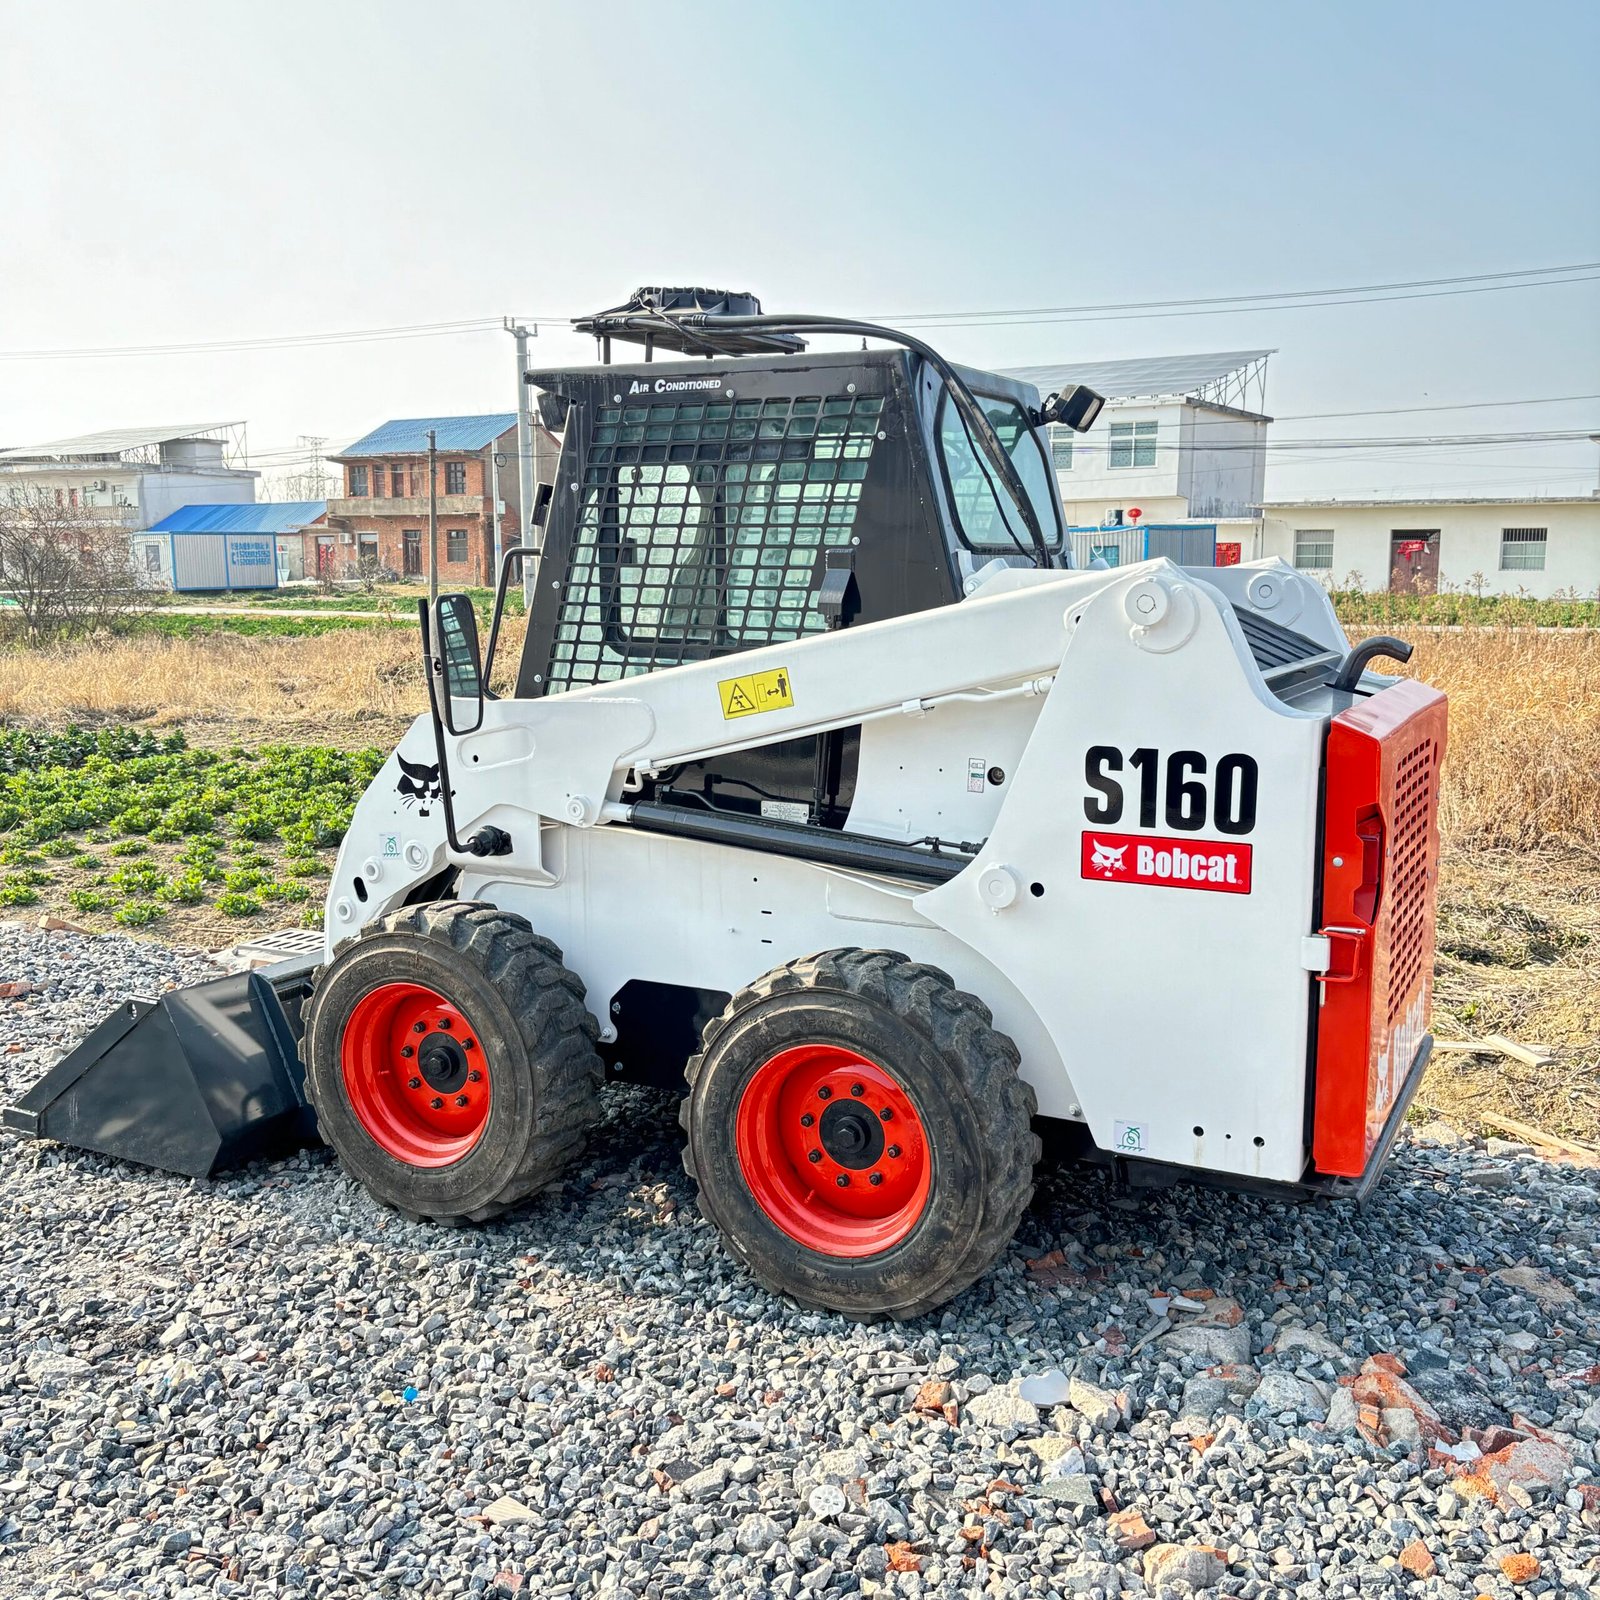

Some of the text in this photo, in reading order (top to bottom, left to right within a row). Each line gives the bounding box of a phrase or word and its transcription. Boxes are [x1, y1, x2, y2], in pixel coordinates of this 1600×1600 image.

[628, 379, 721, 394] AIR CONDITIONED
[1083, 745, 1259, 836] S160
[1136, 844, 1239, 885] Bobcat
